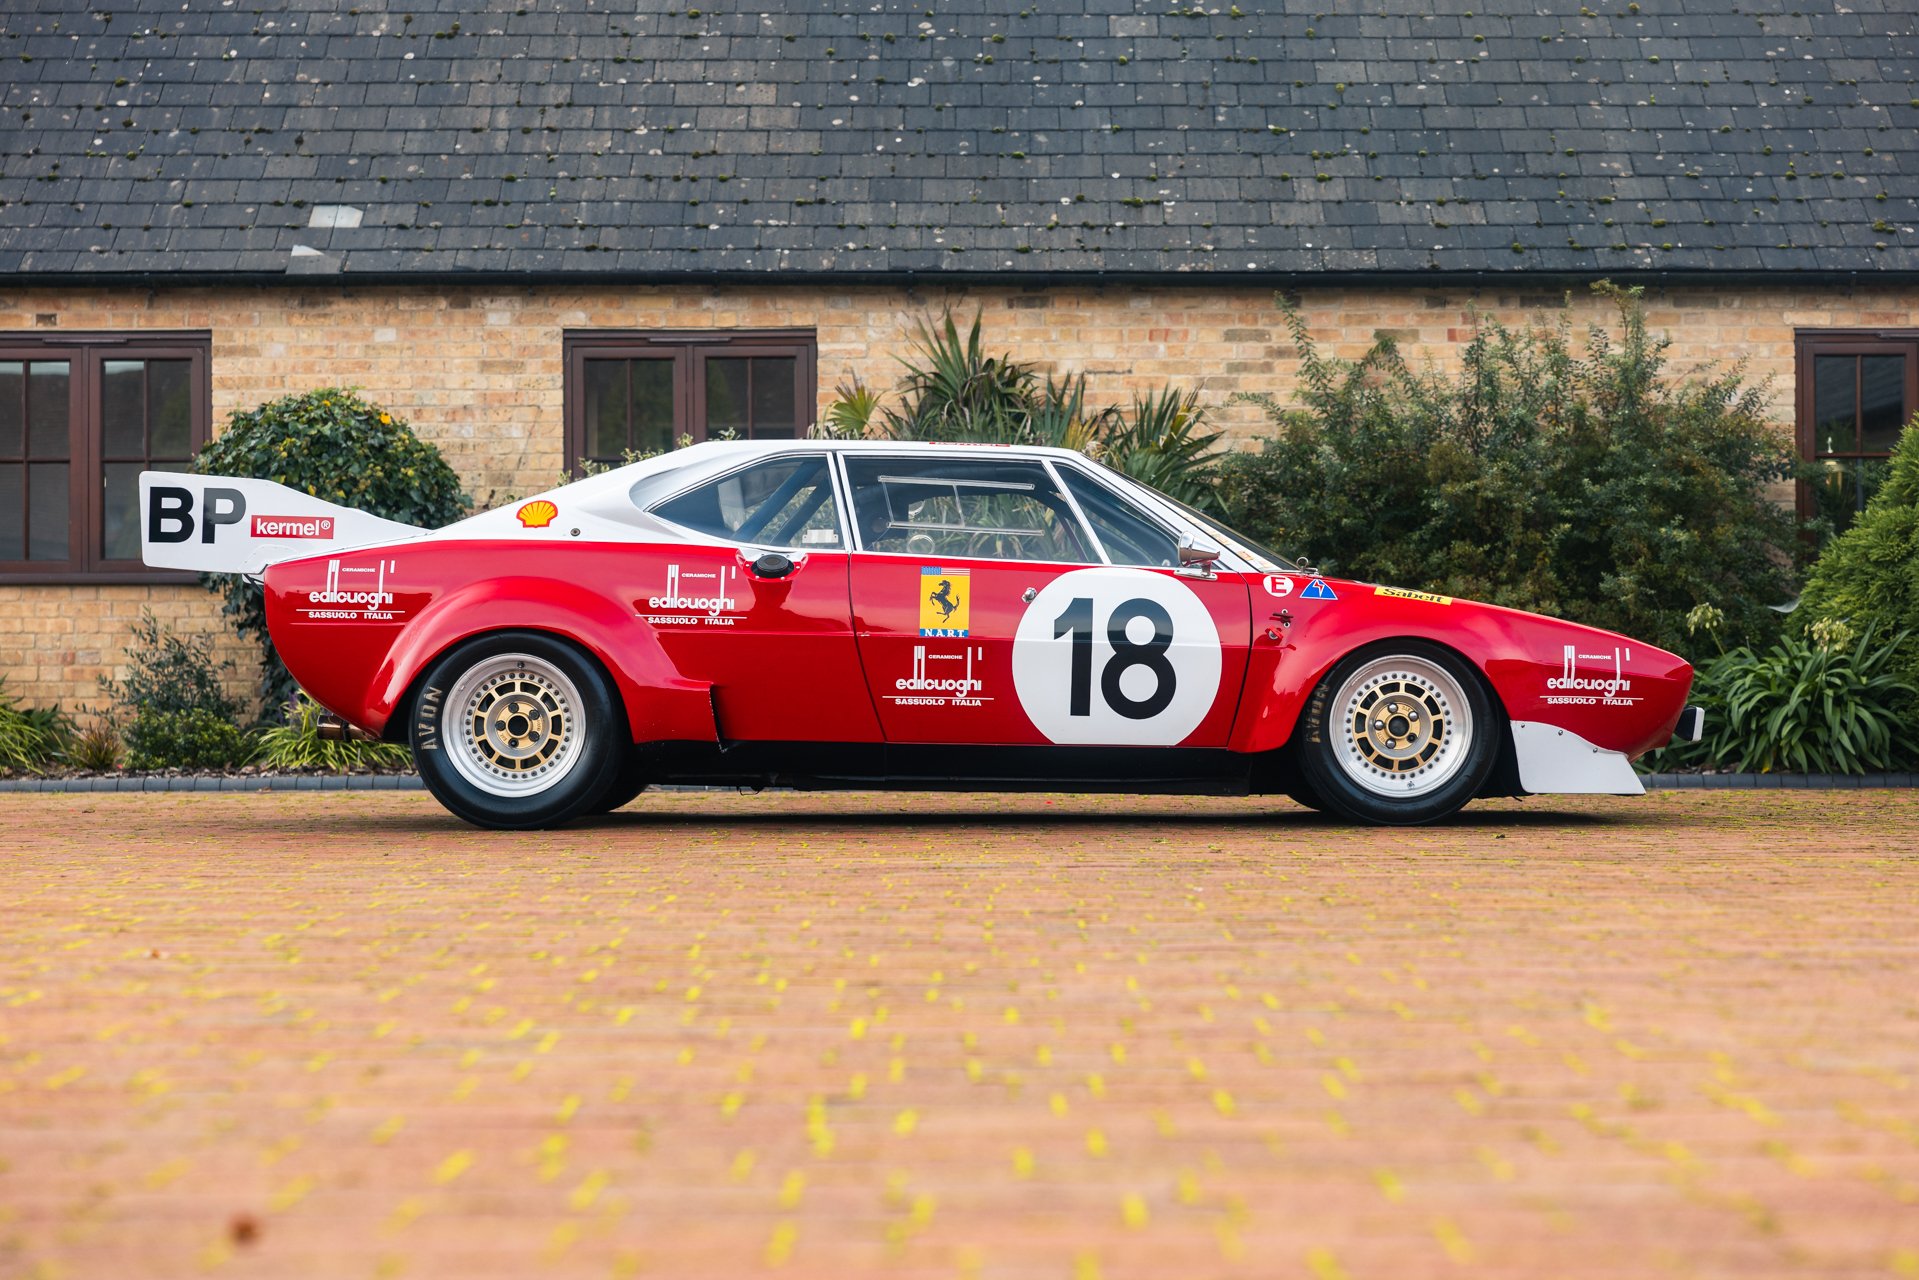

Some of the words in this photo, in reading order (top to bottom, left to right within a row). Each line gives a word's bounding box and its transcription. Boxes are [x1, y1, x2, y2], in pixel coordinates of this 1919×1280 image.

[148, 486, 247, 544] BP
[1270, 576, 1287, 594] E
[308, 611, 358, 620] SASSUOLO
[363, 612, 393, 620] ITALIA
[647, 616, 699, 625] SASSUOLO
[704, 617, 735, 626] ITALIA
[1053, 597, 1177, 720] 18
[895, 698, 946, 706] SASSUOLO
[951, 698, 982, 707] ITALIA
[1547, 697, 1597, 705] SASSUOLO
[1602, 698, 1634, 706] ITALIA
[418, 686, 443, 750] AVON
